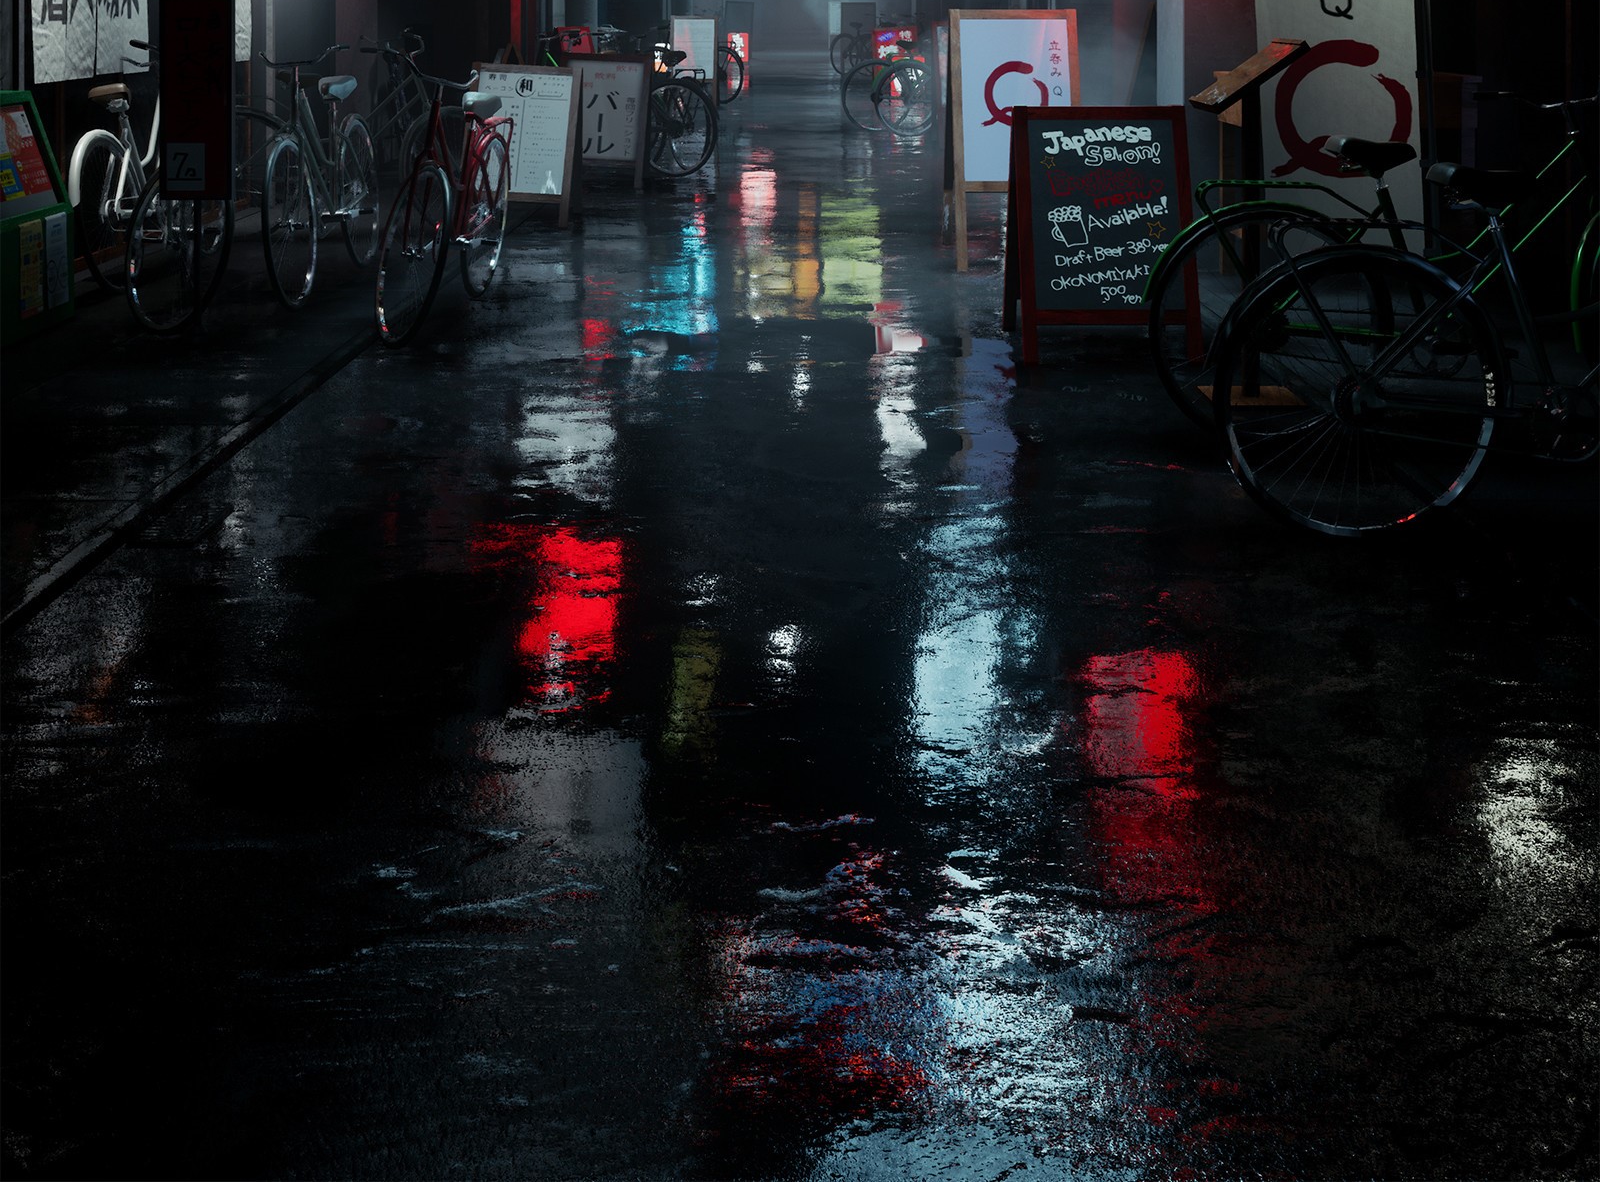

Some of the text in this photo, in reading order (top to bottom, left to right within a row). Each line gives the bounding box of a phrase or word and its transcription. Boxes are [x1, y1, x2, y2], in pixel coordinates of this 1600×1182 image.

[582, 90, 620, 155] バール
[1042, 125, 1152, 156] Japanese
[1088, 195, 1169, 233] Available!
[1093, 189, 1153, 210] menu
[1054, 249, 1093, 267] Draft
[1094, 245, 1125, 262] Beer
[1126, 238, 1152, 255] 380
[1050, 264, 1150, 291] OKONOMIYAKI
[1100, 285, 1126, 304] 500
